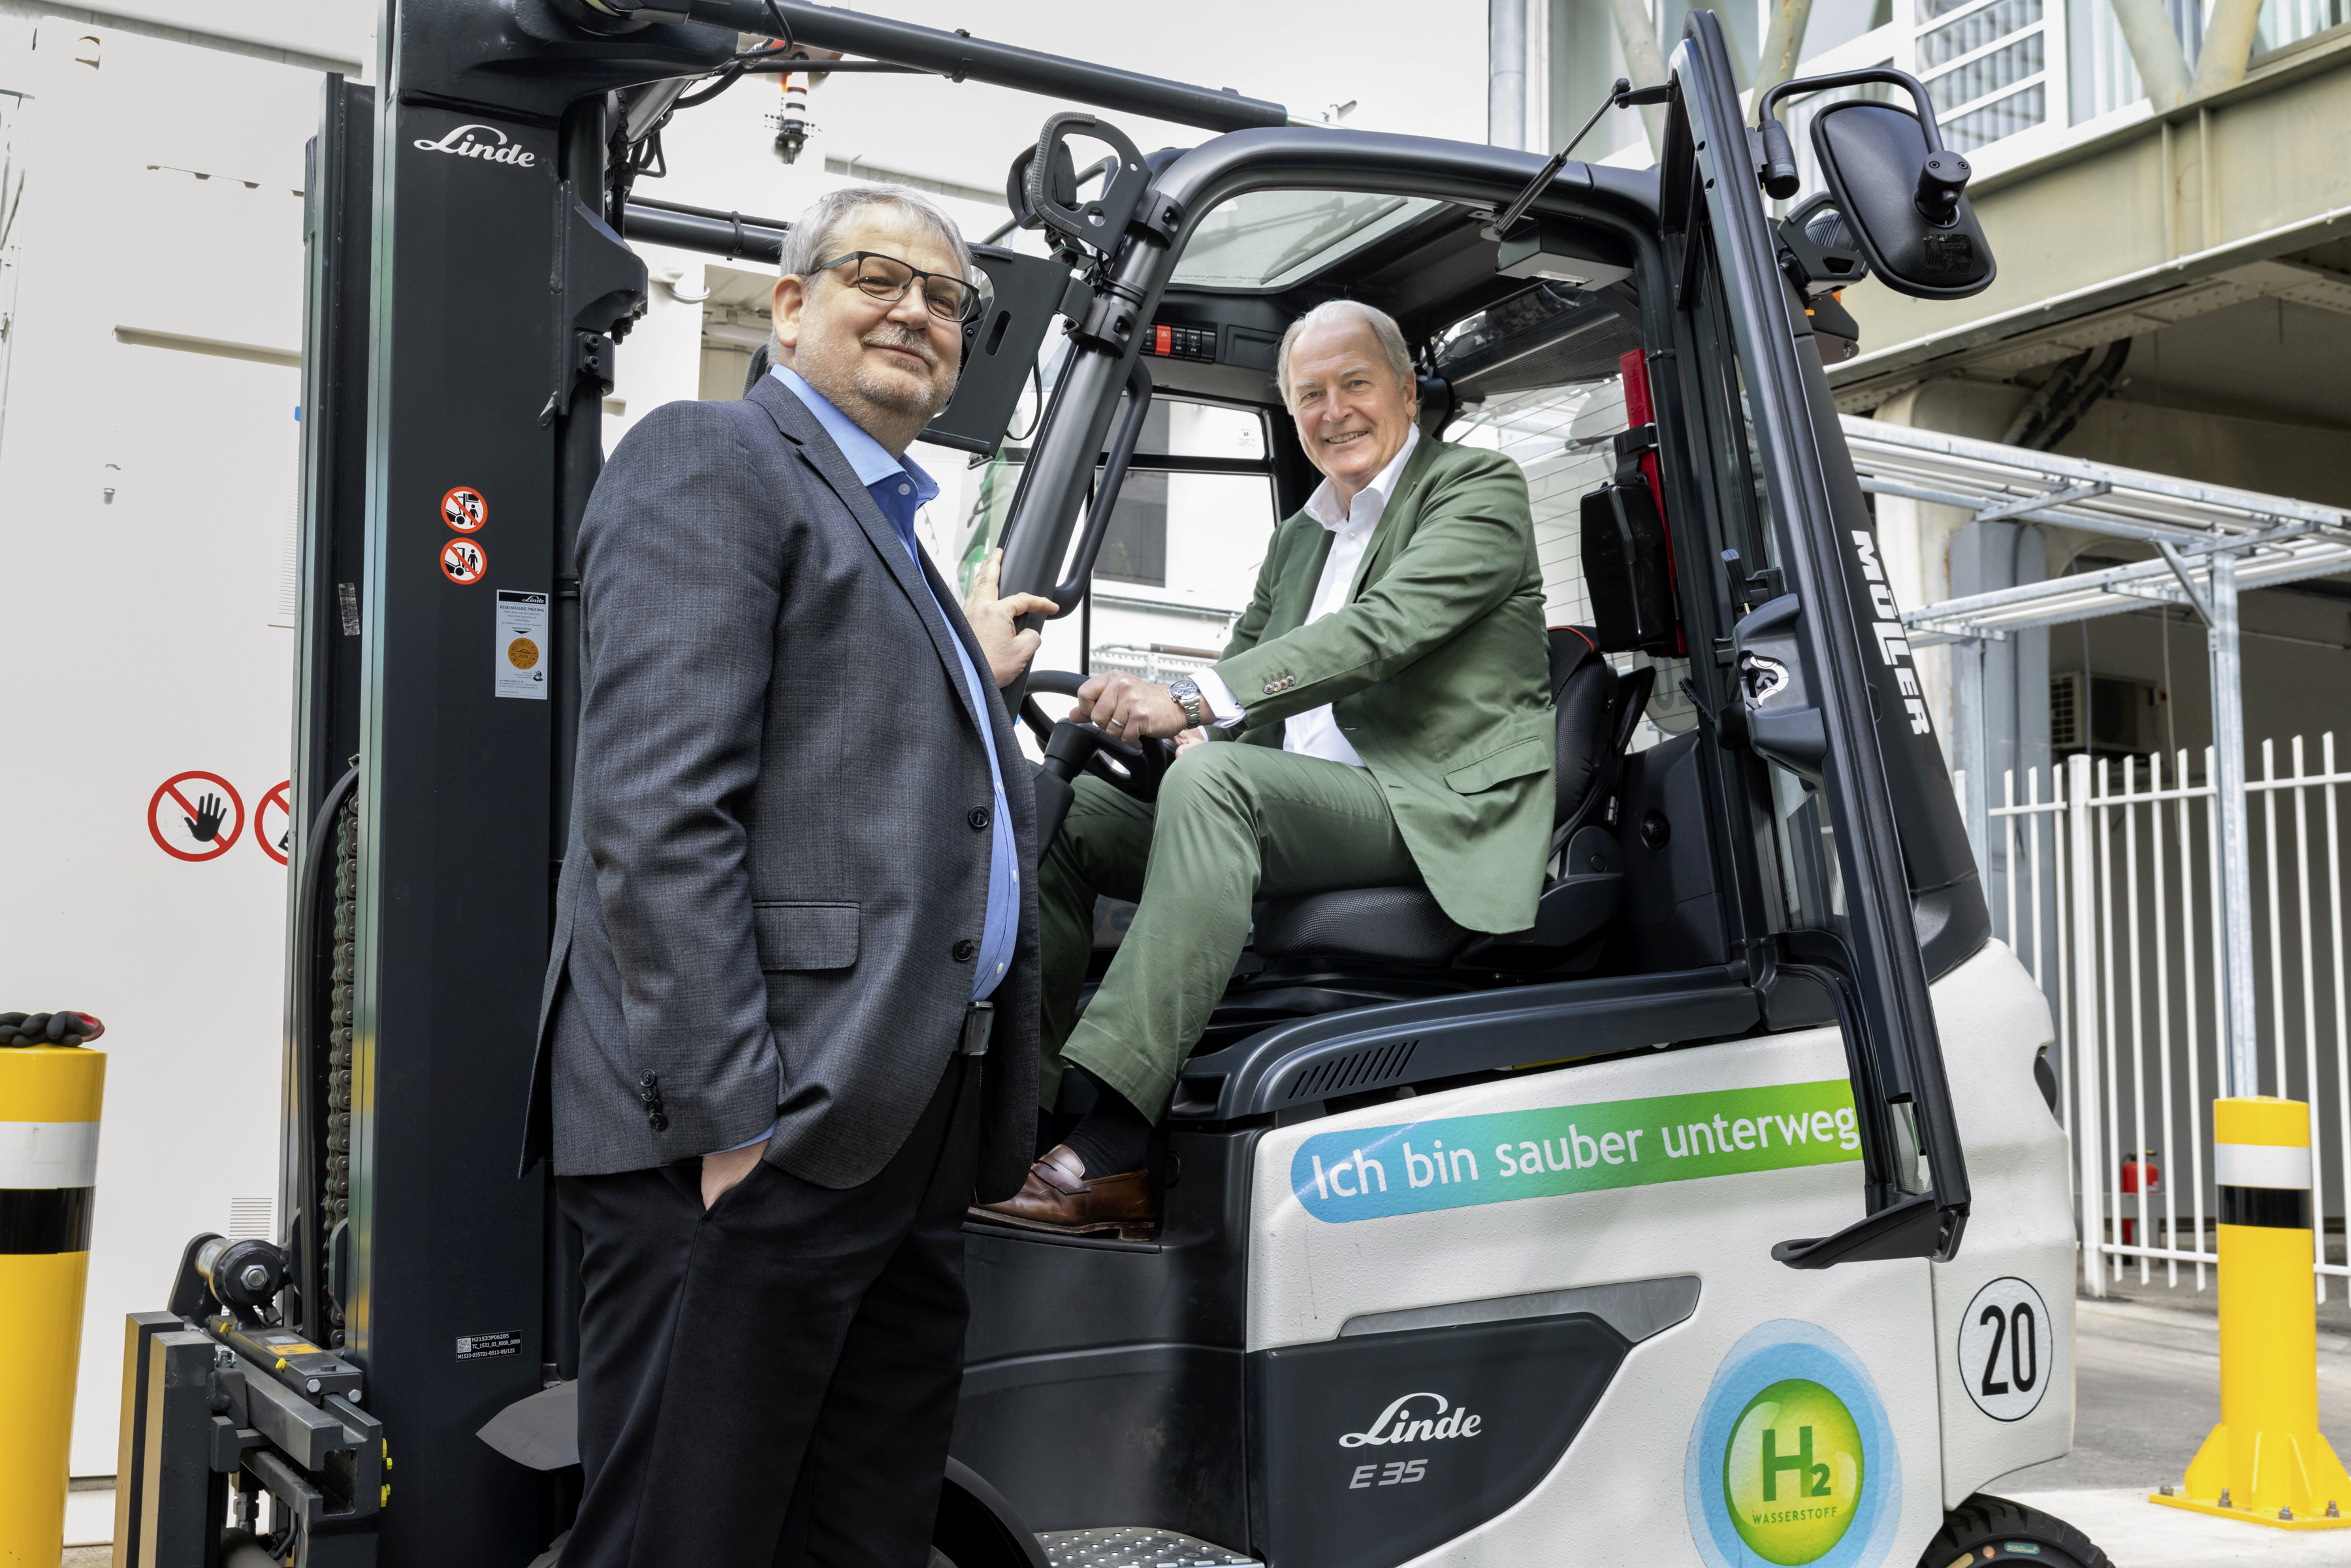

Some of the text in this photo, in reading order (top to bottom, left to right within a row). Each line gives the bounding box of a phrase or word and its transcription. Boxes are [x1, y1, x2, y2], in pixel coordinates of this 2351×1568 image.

[413, 124, 536, 168] Linde
[522, 595, 545, 604] Linde
[1851, 530, 1930, 735] MÜLLER
[1312, 1104, 1863, 1200] Ich bin sauber unterweg
[472, 1333, 509, 1342] H21533P06285
[472, 1339, 520, 1349] TC_1533_03_8000_0080
[1979, 1302, 2037, 1397] 20
[1339, 1392, 1482, 1448] Linde
[1349, 1458, 1429, 1490] E 35
[1762, 1425, 1832, 1502] H2
[1751, 1506, 1838, 1526] WASSERSTOFF
